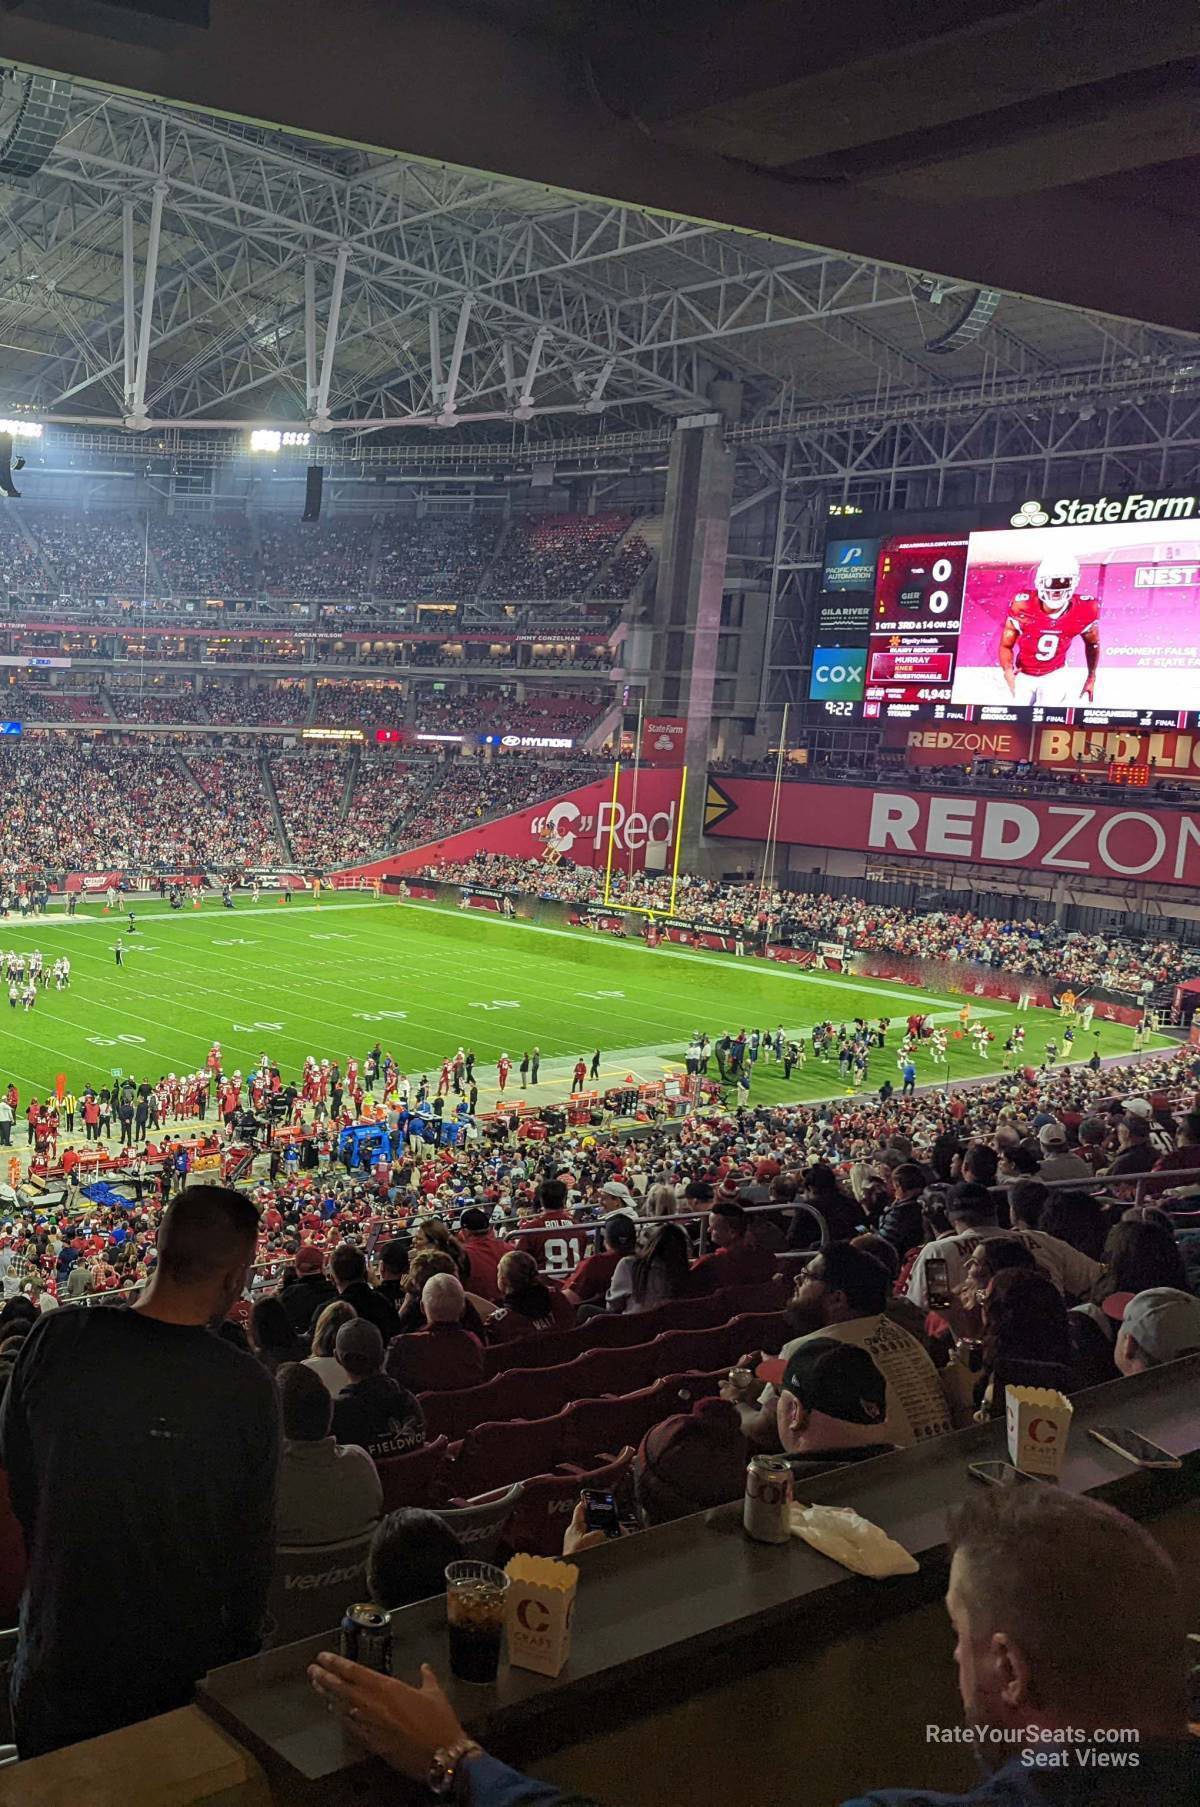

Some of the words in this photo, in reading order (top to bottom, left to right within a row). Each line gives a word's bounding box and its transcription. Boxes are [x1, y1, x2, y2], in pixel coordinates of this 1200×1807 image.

[827, 572, 871, 580] AUTOMATION
[932, 558, 952, 582] 0
[1137, 568, 1197, 586] NEST
[929, 590, 949, 613] 0
[821, 608, 842, 616] GILA
[843, 607, 870, 615] RIVER
[946, 620, 960, 629] 50
[1036, 634, 1060, 662] 9
[1106, 647, 1164, 656] OPPONENT
[895, 656, 930, 664] MURRAY
[815, 665, 863, 683] COX
[917, 689, 952, 701] 41,943
[824, 701, 854, 716] 9:22
[1083, 710, 1138, 718] BUCCANEERS
[1046, 715, 1065, 723] FINAL
[1154, 719, 1176, 727] FINAL
[521, 736, 572, 748] HYUNDAI
[907, 730, 1012, 752] REDZONE
[1039, 729, 1140, 763] BUD
[593, 800, 676, 850] Red
[664, 919, 693, 930] ARIZONA
[233, 1022, 284, 1032] 40
[84, 1034, 147, 1045] 50
[544, 1238, 580, 1279] 81
[517, 1600, 550, 1632] C
